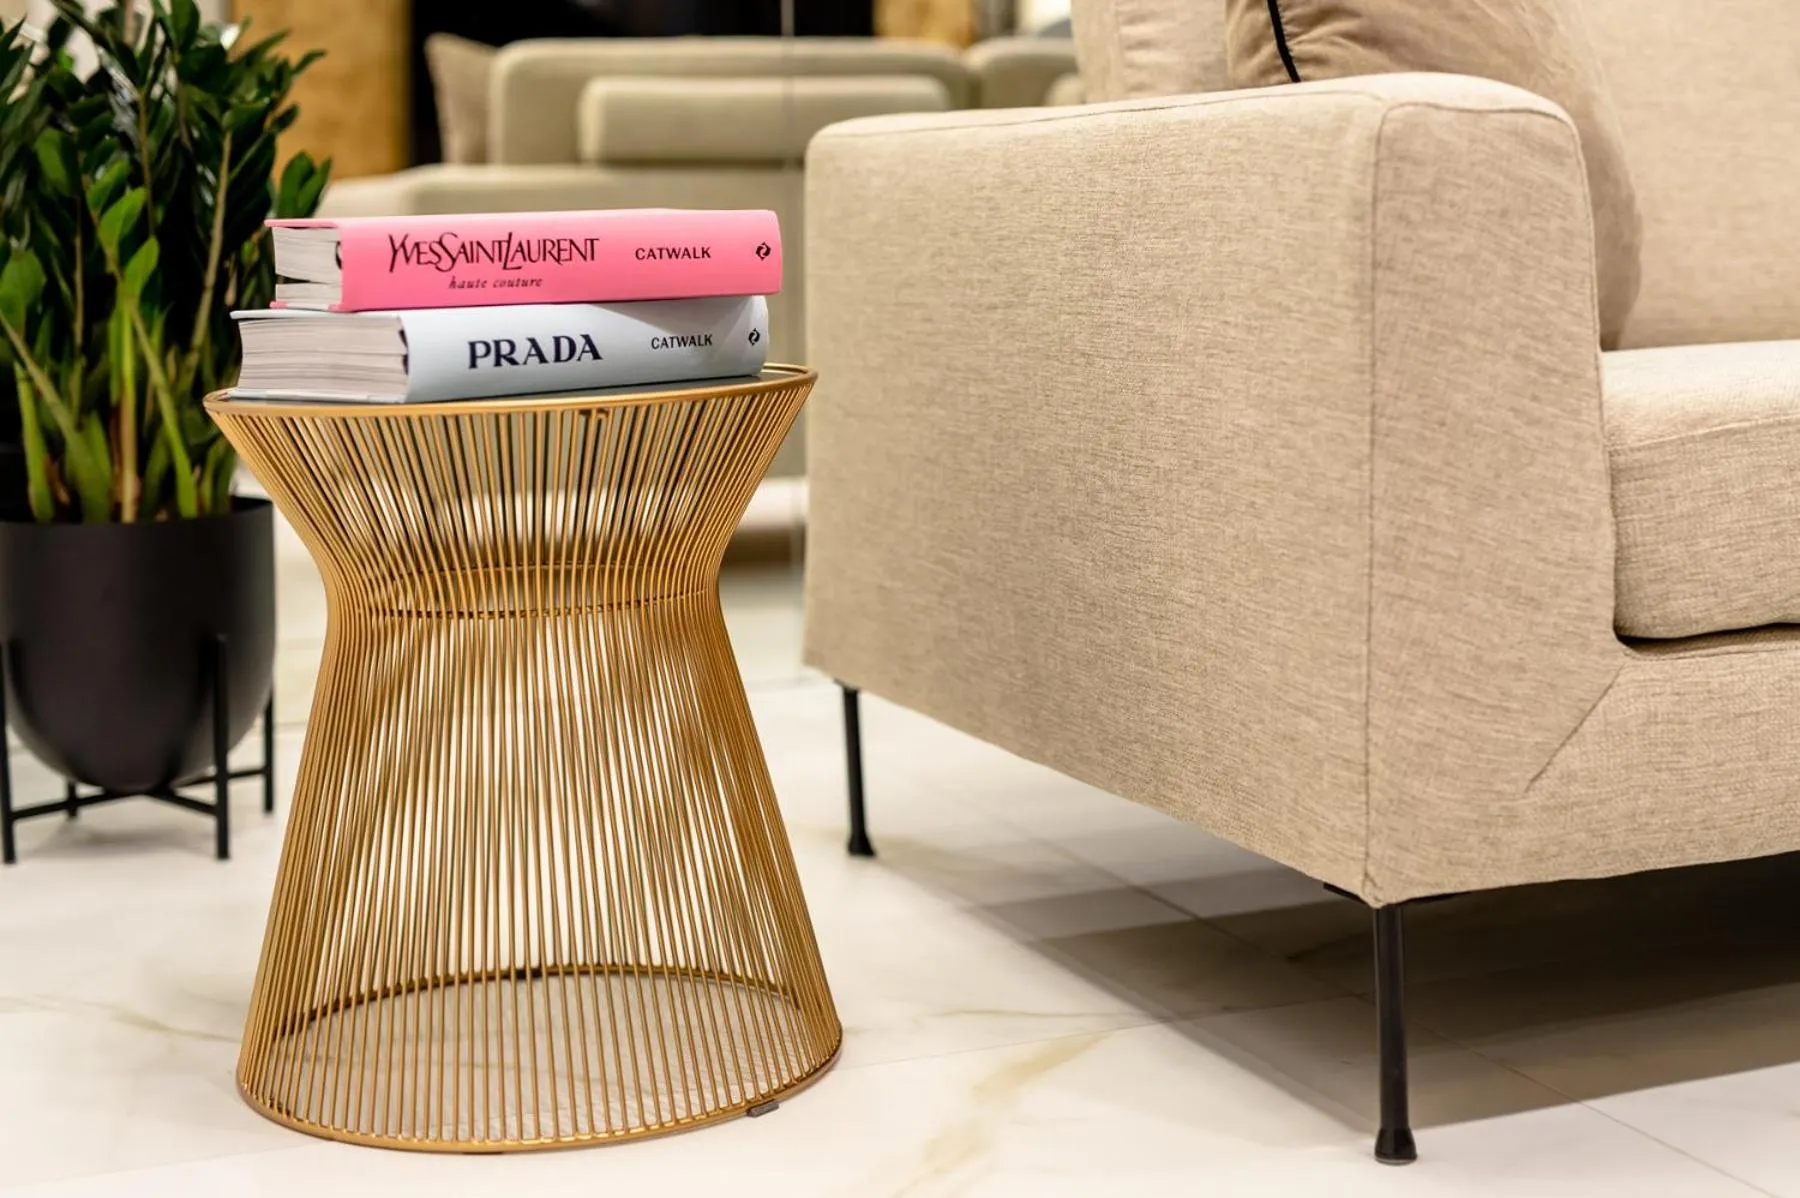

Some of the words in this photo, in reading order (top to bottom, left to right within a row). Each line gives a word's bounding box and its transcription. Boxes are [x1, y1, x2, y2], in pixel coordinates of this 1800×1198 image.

[635, 246, 711, 260] CATWALK
[449, 276, 488, 289] haute
[493, 276, 543, 288] couture
[468, 333, 602, 369] PRADA
[651, 334, 713, 350] CATWALK
